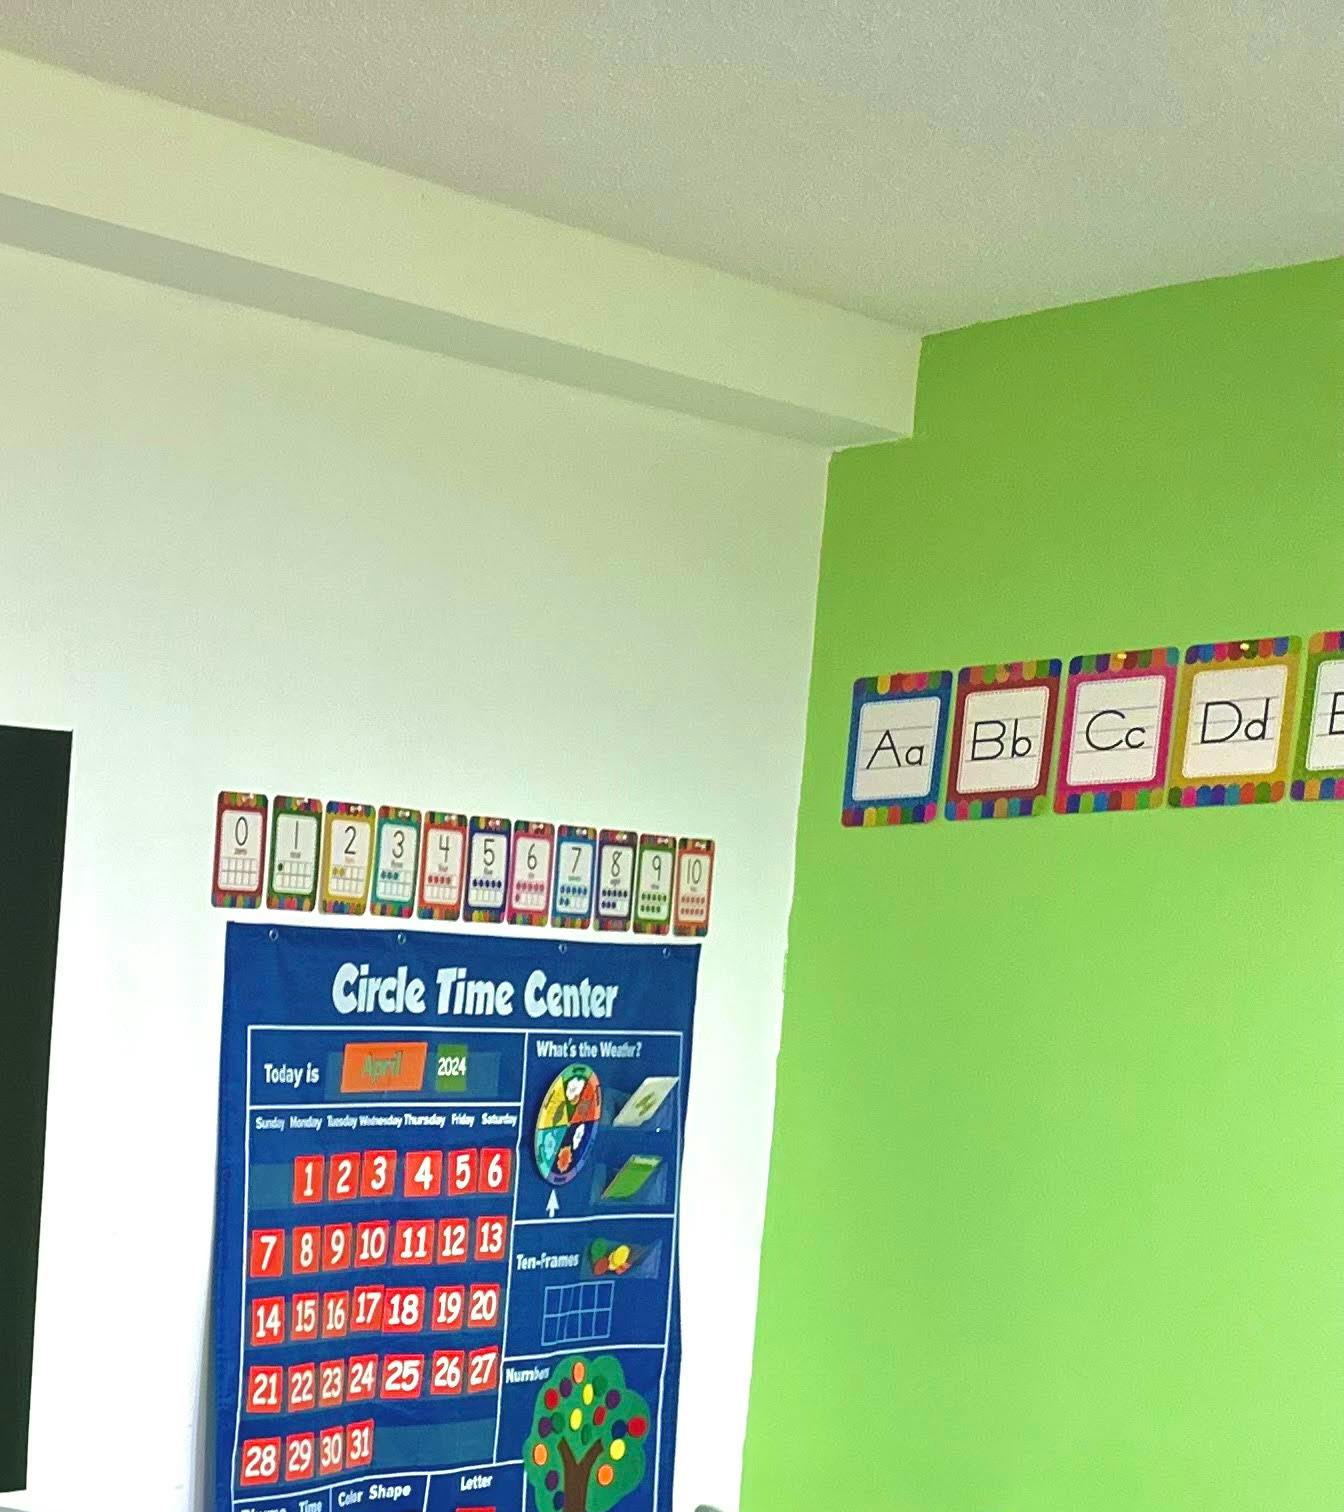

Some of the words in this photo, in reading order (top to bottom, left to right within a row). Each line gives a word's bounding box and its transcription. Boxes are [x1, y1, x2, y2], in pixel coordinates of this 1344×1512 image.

[1085, 708, 1146, 752] Cc
[1200, 697, 1271, 744] Dd
[866, 729, 925, 769] Aa
[970, 718, 1033, 761] Bb
[235, 816, 248, 847] 0
[293, 821, 299, 850] 1
[344, 825, 357, 856] 2
[392, 830, 405, 859] 3
[438, 836, 450, 863] 4
[483, 839, 495, 866] 5
[527, 843, 537, 870] 6
[571, 847, 581, 874] 7
[610, 849, 620, 877] 8
[651, 854, 662, 883] 9
[686, 858, 702, 886] 10
[331, 962, 426, 1016] Circle
[436, 968, 514, 1017] Time
[524, 970, 620, 1018] Center
[536, 1038, 577, 1058] What's
[578, 1041, 598, 1058] the
[264, 1063, 302, 1085] Today
[305, 1063, 319, 1082] is
[437, 1056, 467, 1076] 2024
[255, 1116, 285, 1131] Sunday
[289, 1116, 323, 1131] Monday
[326, 1114, 358, 1130] Tuesday
[359, 1114, 403, 1129] Wednesday
[403, 1113, 445, 1128] Thursday
[451, 1113, 475, 1128] Friday
[481, 1113, 518, 1127] Saturday
[303, 1162, 314, 1197] 1
[336, 1159, 352, 1193] 2
[371, 1156, 387, 1190] 3
[414, 1156, 433, 1190] 4
[455, 1154, 471, 1189] 5
[487, 1153, 503, 1188] 6
[259, 1236, 277, 1268] 7
[299, 1233, 313, 1267] 8
[329, 1230, 344, 1264] 9
[360, 1227, 384, 1261] 10
[401, 1226, 429, 1259] 11
[442, 1224, 464, 1258] 12
[480, 1222, 503, 1255] 13
[516, 1253, 579, 1271] Ten-frames
[255, 1306, 281, 1337] 14
[296, 1302, 315, 1334] 15
[327, 1299, 345, 1331] 16
[355, 1291, 379, 1325] 17
[388, 1294, 419, 1326] 18
[437, 1292, 459, 1324] 19
[471, 1289, 496, 1322] 20
[254, 1374, 278, 1406] 21
[290, 1370, 313, 1404] 22
[322, 1367, 342, 1399] 23
[349, 1361, 375, 1394] 24
[386, 1358, 420, 1392] 25
[436, 1356, 461, 1389] 26
[471, 1353, 495, 1385] 27
[505, 1366, 550, 1384] Number
[246, 1444, 277, 1478] 28
[288, 1439, 311, 1472] 29
[322, 1436, 342, 1467] 30
[350, 1428, 369, 1459] 31
[368, 1483, 411, 1501] Shape
[460, 1473, 493, 1493] Letter
[337, 1489, 363, 1508] Color
